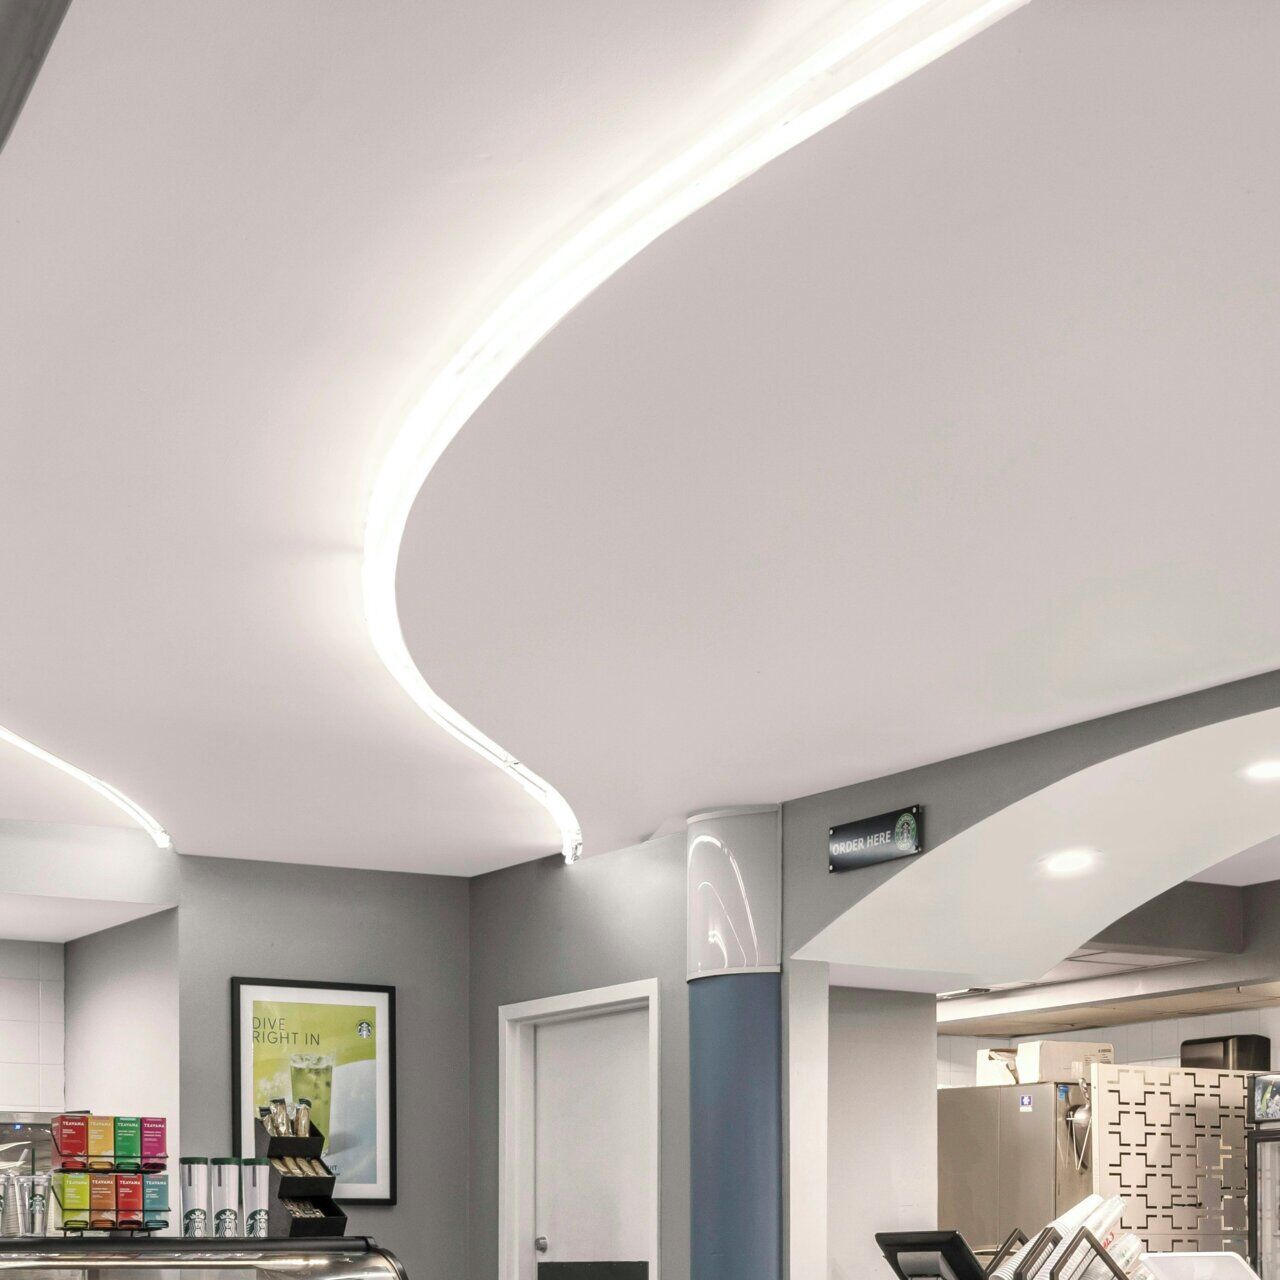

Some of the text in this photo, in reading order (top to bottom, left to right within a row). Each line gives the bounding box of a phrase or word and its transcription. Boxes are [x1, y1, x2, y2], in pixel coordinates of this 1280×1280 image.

[832, 831, 892, 856] ORDER HERE
[253, 1017, 285, 1031] DIVE
[253, 1031, 320, 1046] RIGHT IN
